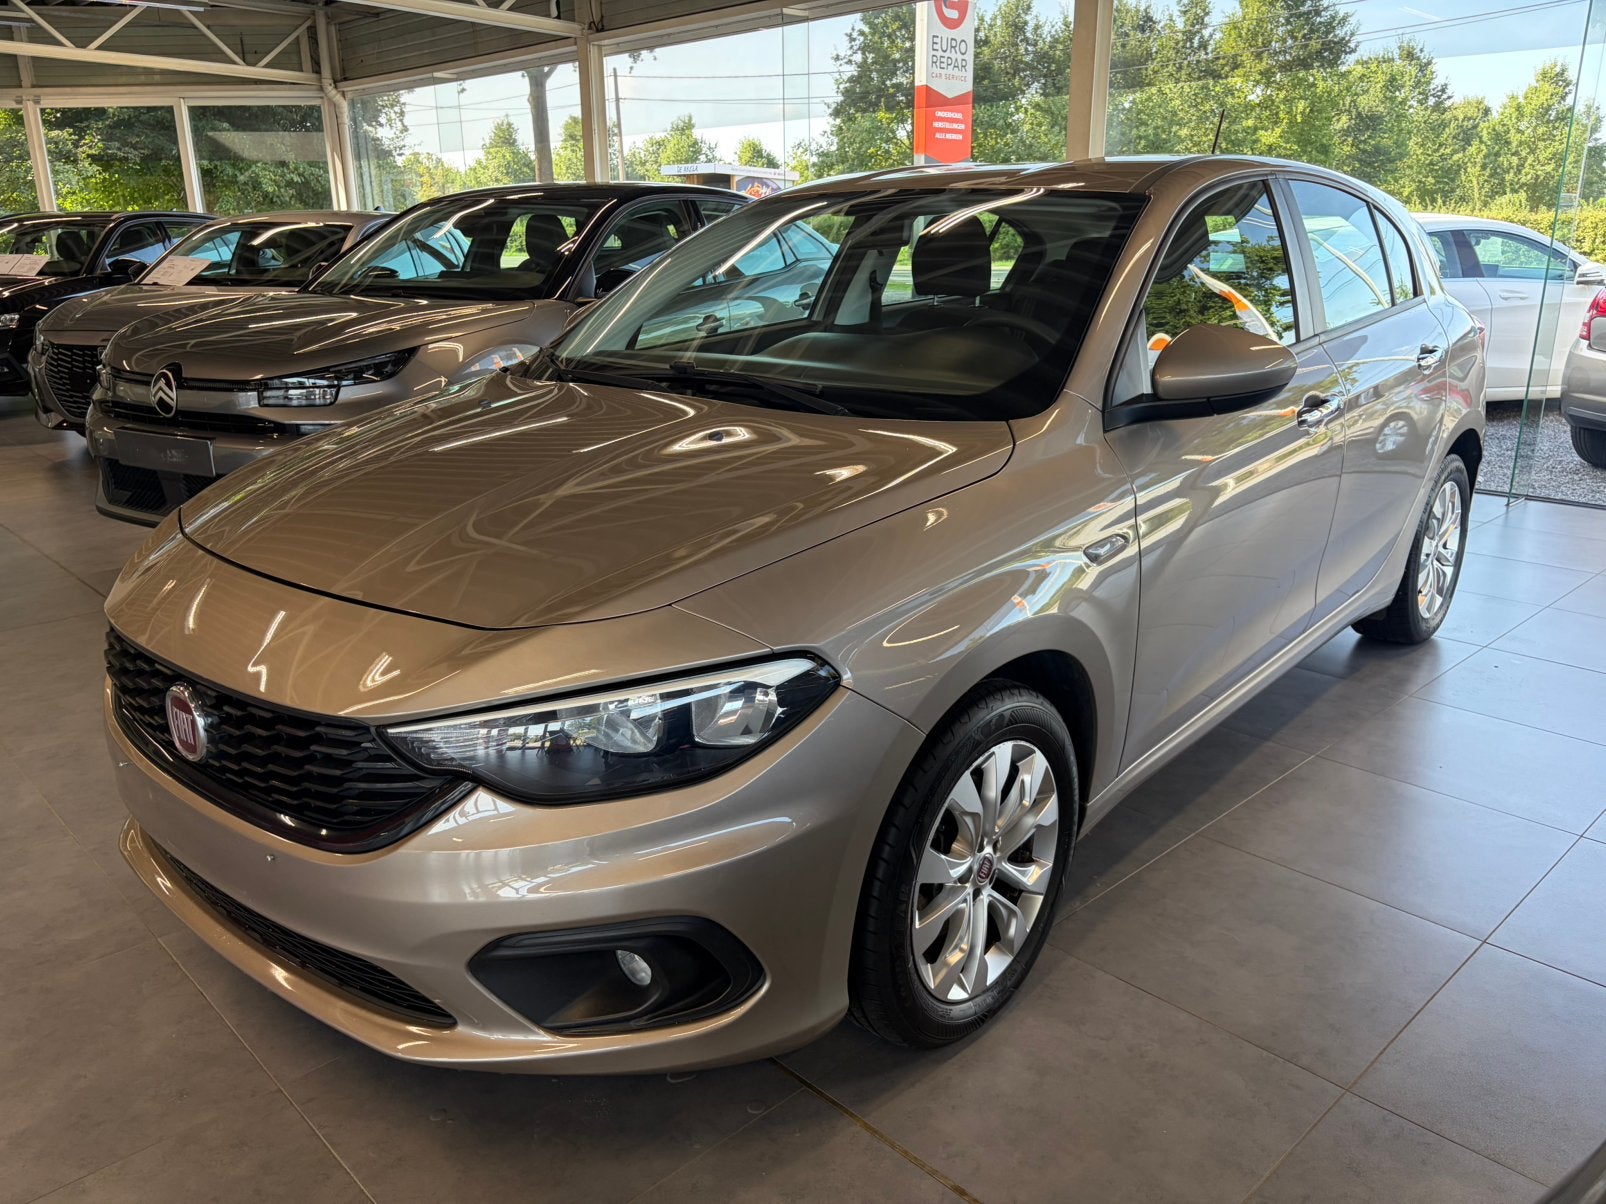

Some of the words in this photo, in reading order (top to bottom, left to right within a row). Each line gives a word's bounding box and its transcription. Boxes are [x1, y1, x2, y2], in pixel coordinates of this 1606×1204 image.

[931, 35, 968, 55] EURO
[931, 54, 968, 72] REPAR
[944, 73, 968, 82] SERVICE
[172, 705, 195, 745] FIAT
[979, 860, 990, 878] FIAT
